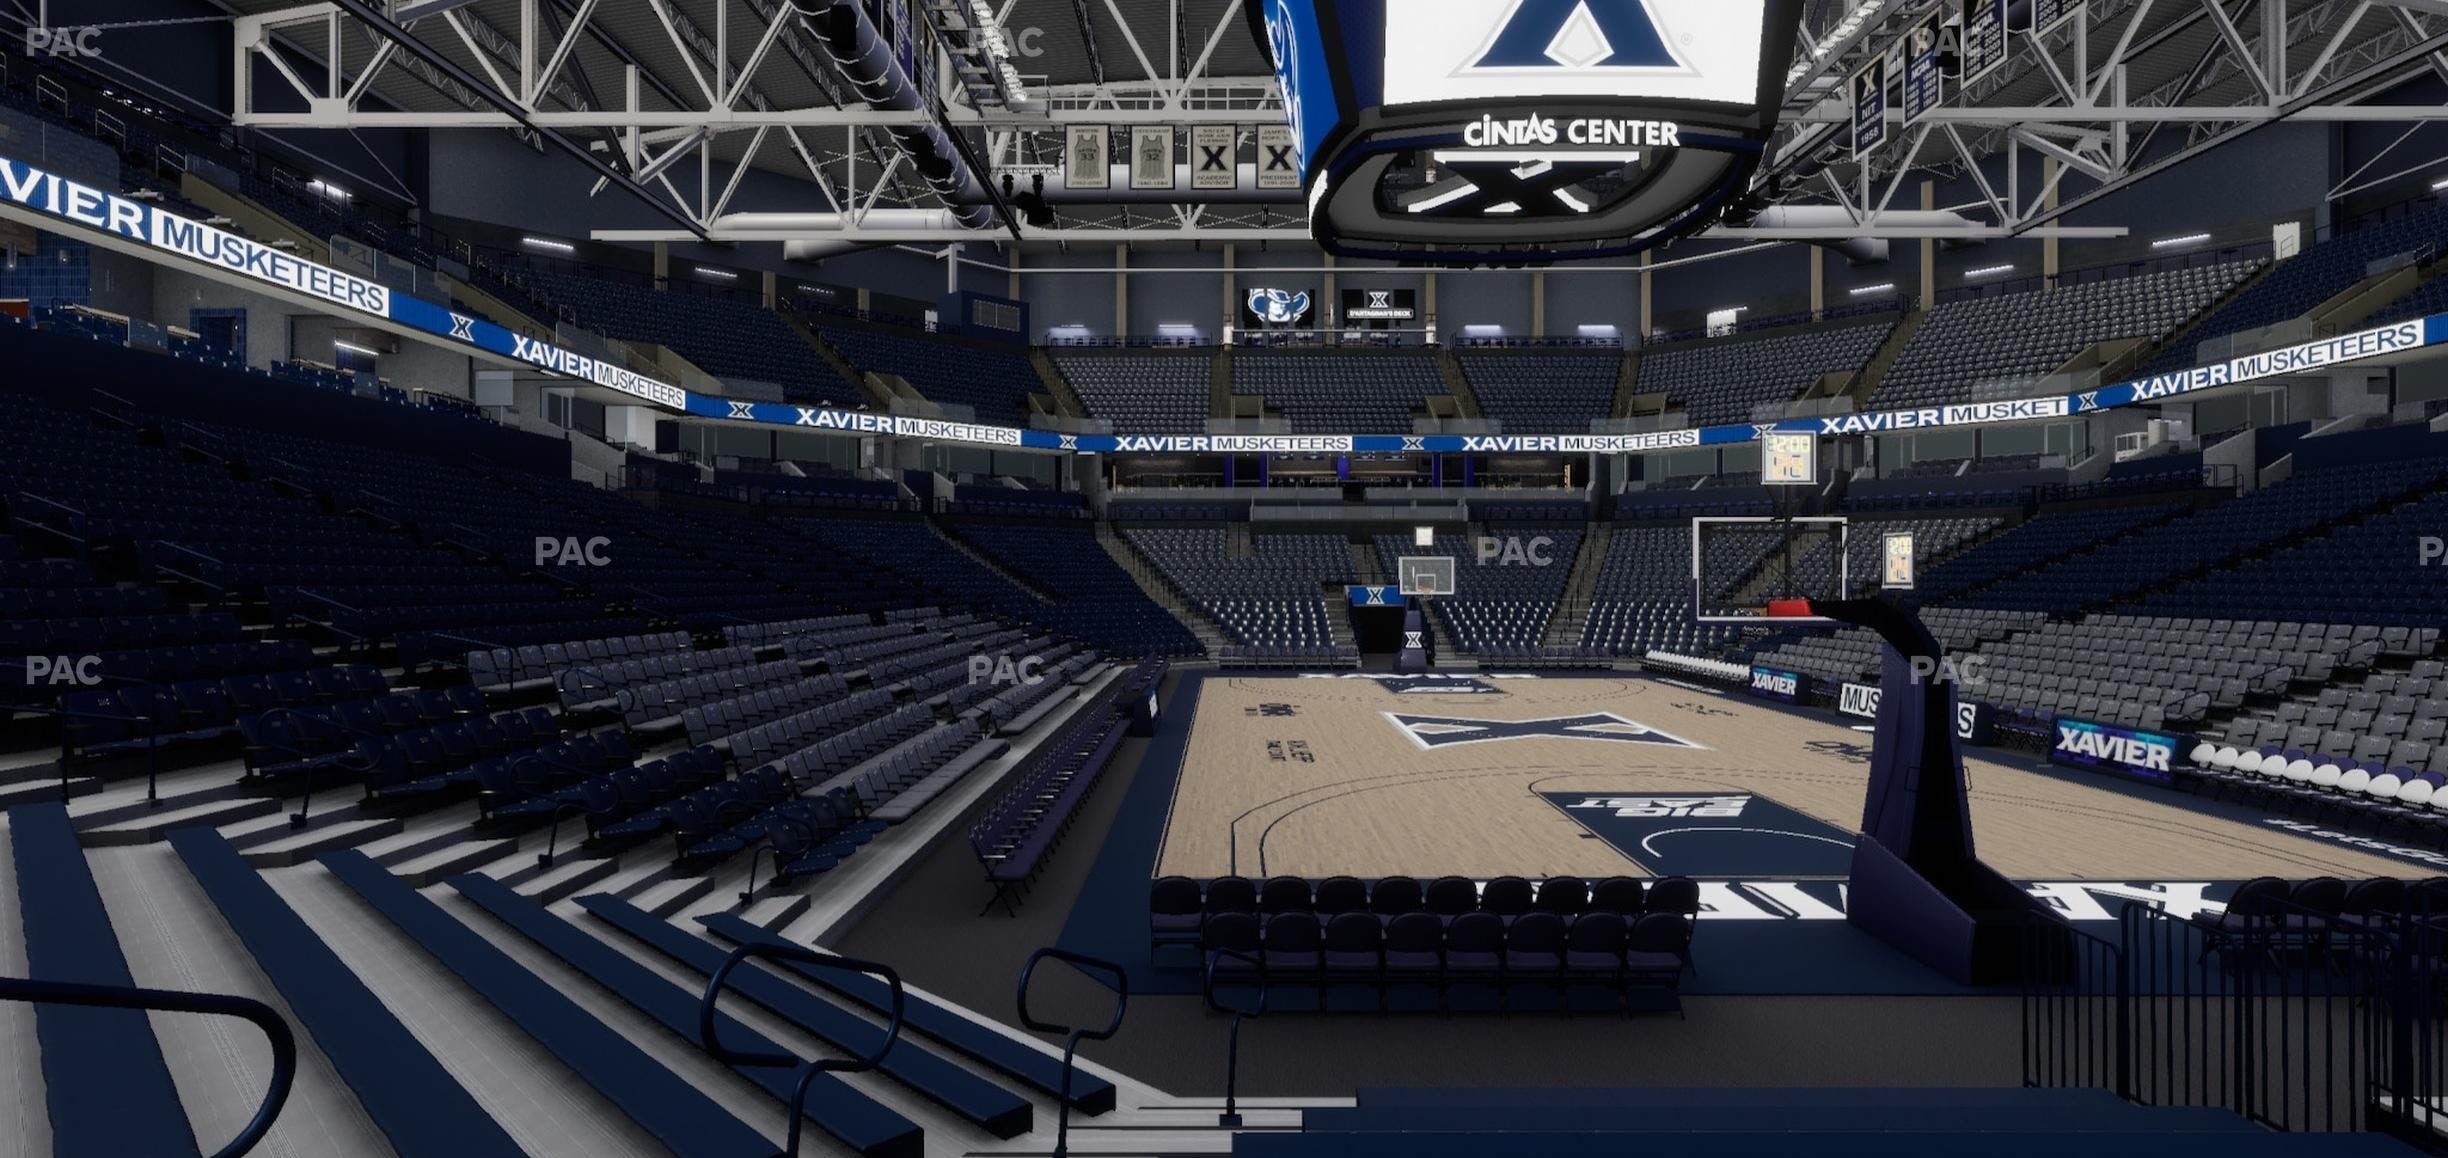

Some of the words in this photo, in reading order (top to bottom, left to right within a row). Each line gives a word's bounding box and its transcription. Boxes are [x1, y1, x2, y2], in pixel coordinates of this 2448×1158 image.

[1862, 101, 1876, 121] NIT
[1567, 119, 1680, 146] CENTER
[1861, 126, 1879, 145] 1958
[1200, 145, 1227, 171] X
[1266, 145, 1293, 171] X
[0, 157, 146, 241] VIER
[162, 216, 384, 312] MUSKETEERS
[450, 312, 475, 342] X
[511, 333, 592, 380] XAVIER
[599, 364, 684, 408] MUSKETEERS
[2131, 363, 2229, 401] XAVIER
[2237, 324, 2418, 380] MUSKETEERS
[728, 401, 754, 419] X
[2079, 391, 2098, 411] X
[796, 408, 893, 433] XAVIER
[901, 418, 1017, 443] MUSKETEERS
[1821, 409, 1942, 434] XAVIER
[1952, 399, 2064, 423] MUSKET
[1059, 435, 1077, 450] X
[1115, 436, 1209, 450] XAVIER
[1217, 437, 1349, 450] MUSKETEERS
[1402, 436, 1424, 450] X
[1462, 436, 1557, 451] XAVIER
[1564, 432, 1695, 450] MUSKETEERS
[1366, 587, 1384, 605] X
[1405, 631, 1422, 648] X
[1751, 671, 1797, 695] XAVIER
[2058, 726, 2172, 772] XAVIER
